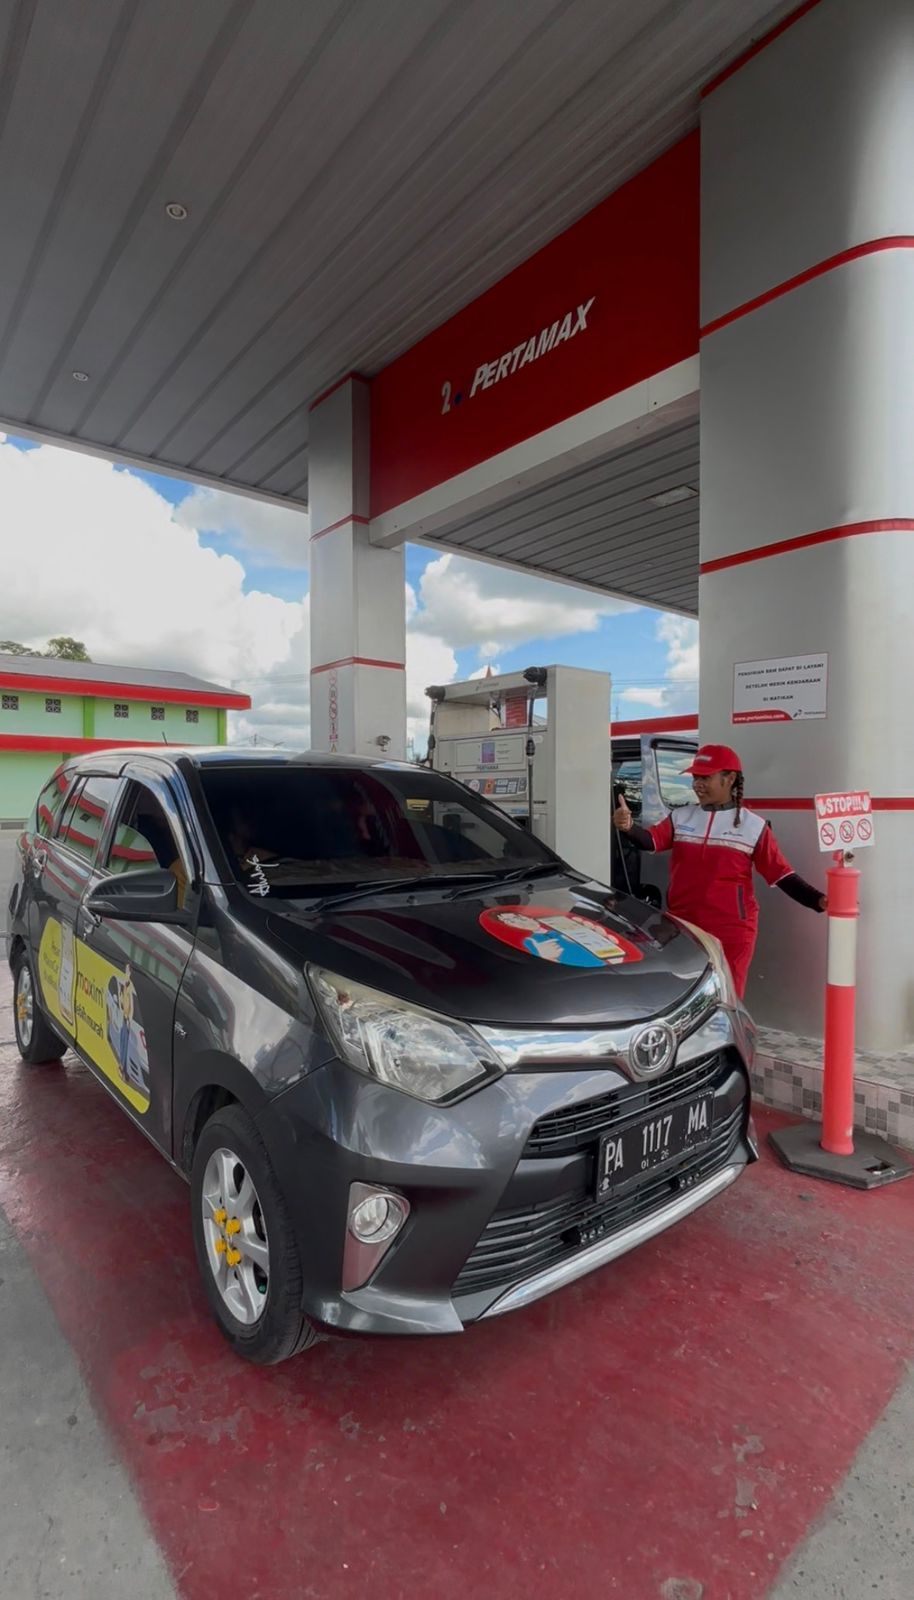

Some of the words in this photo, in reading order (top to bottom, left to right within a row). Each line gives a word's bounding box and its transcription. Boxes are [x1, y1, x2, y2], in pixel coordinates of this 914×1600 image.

[469, 295, 596, 399] PERTAMAX
[826, 795, 861, 813] STOP!!!
[604, 1138, 623, 1174] PA
[642, 1115, 672, 1156] 1117
[687, 1100, 707, 1134] MA
